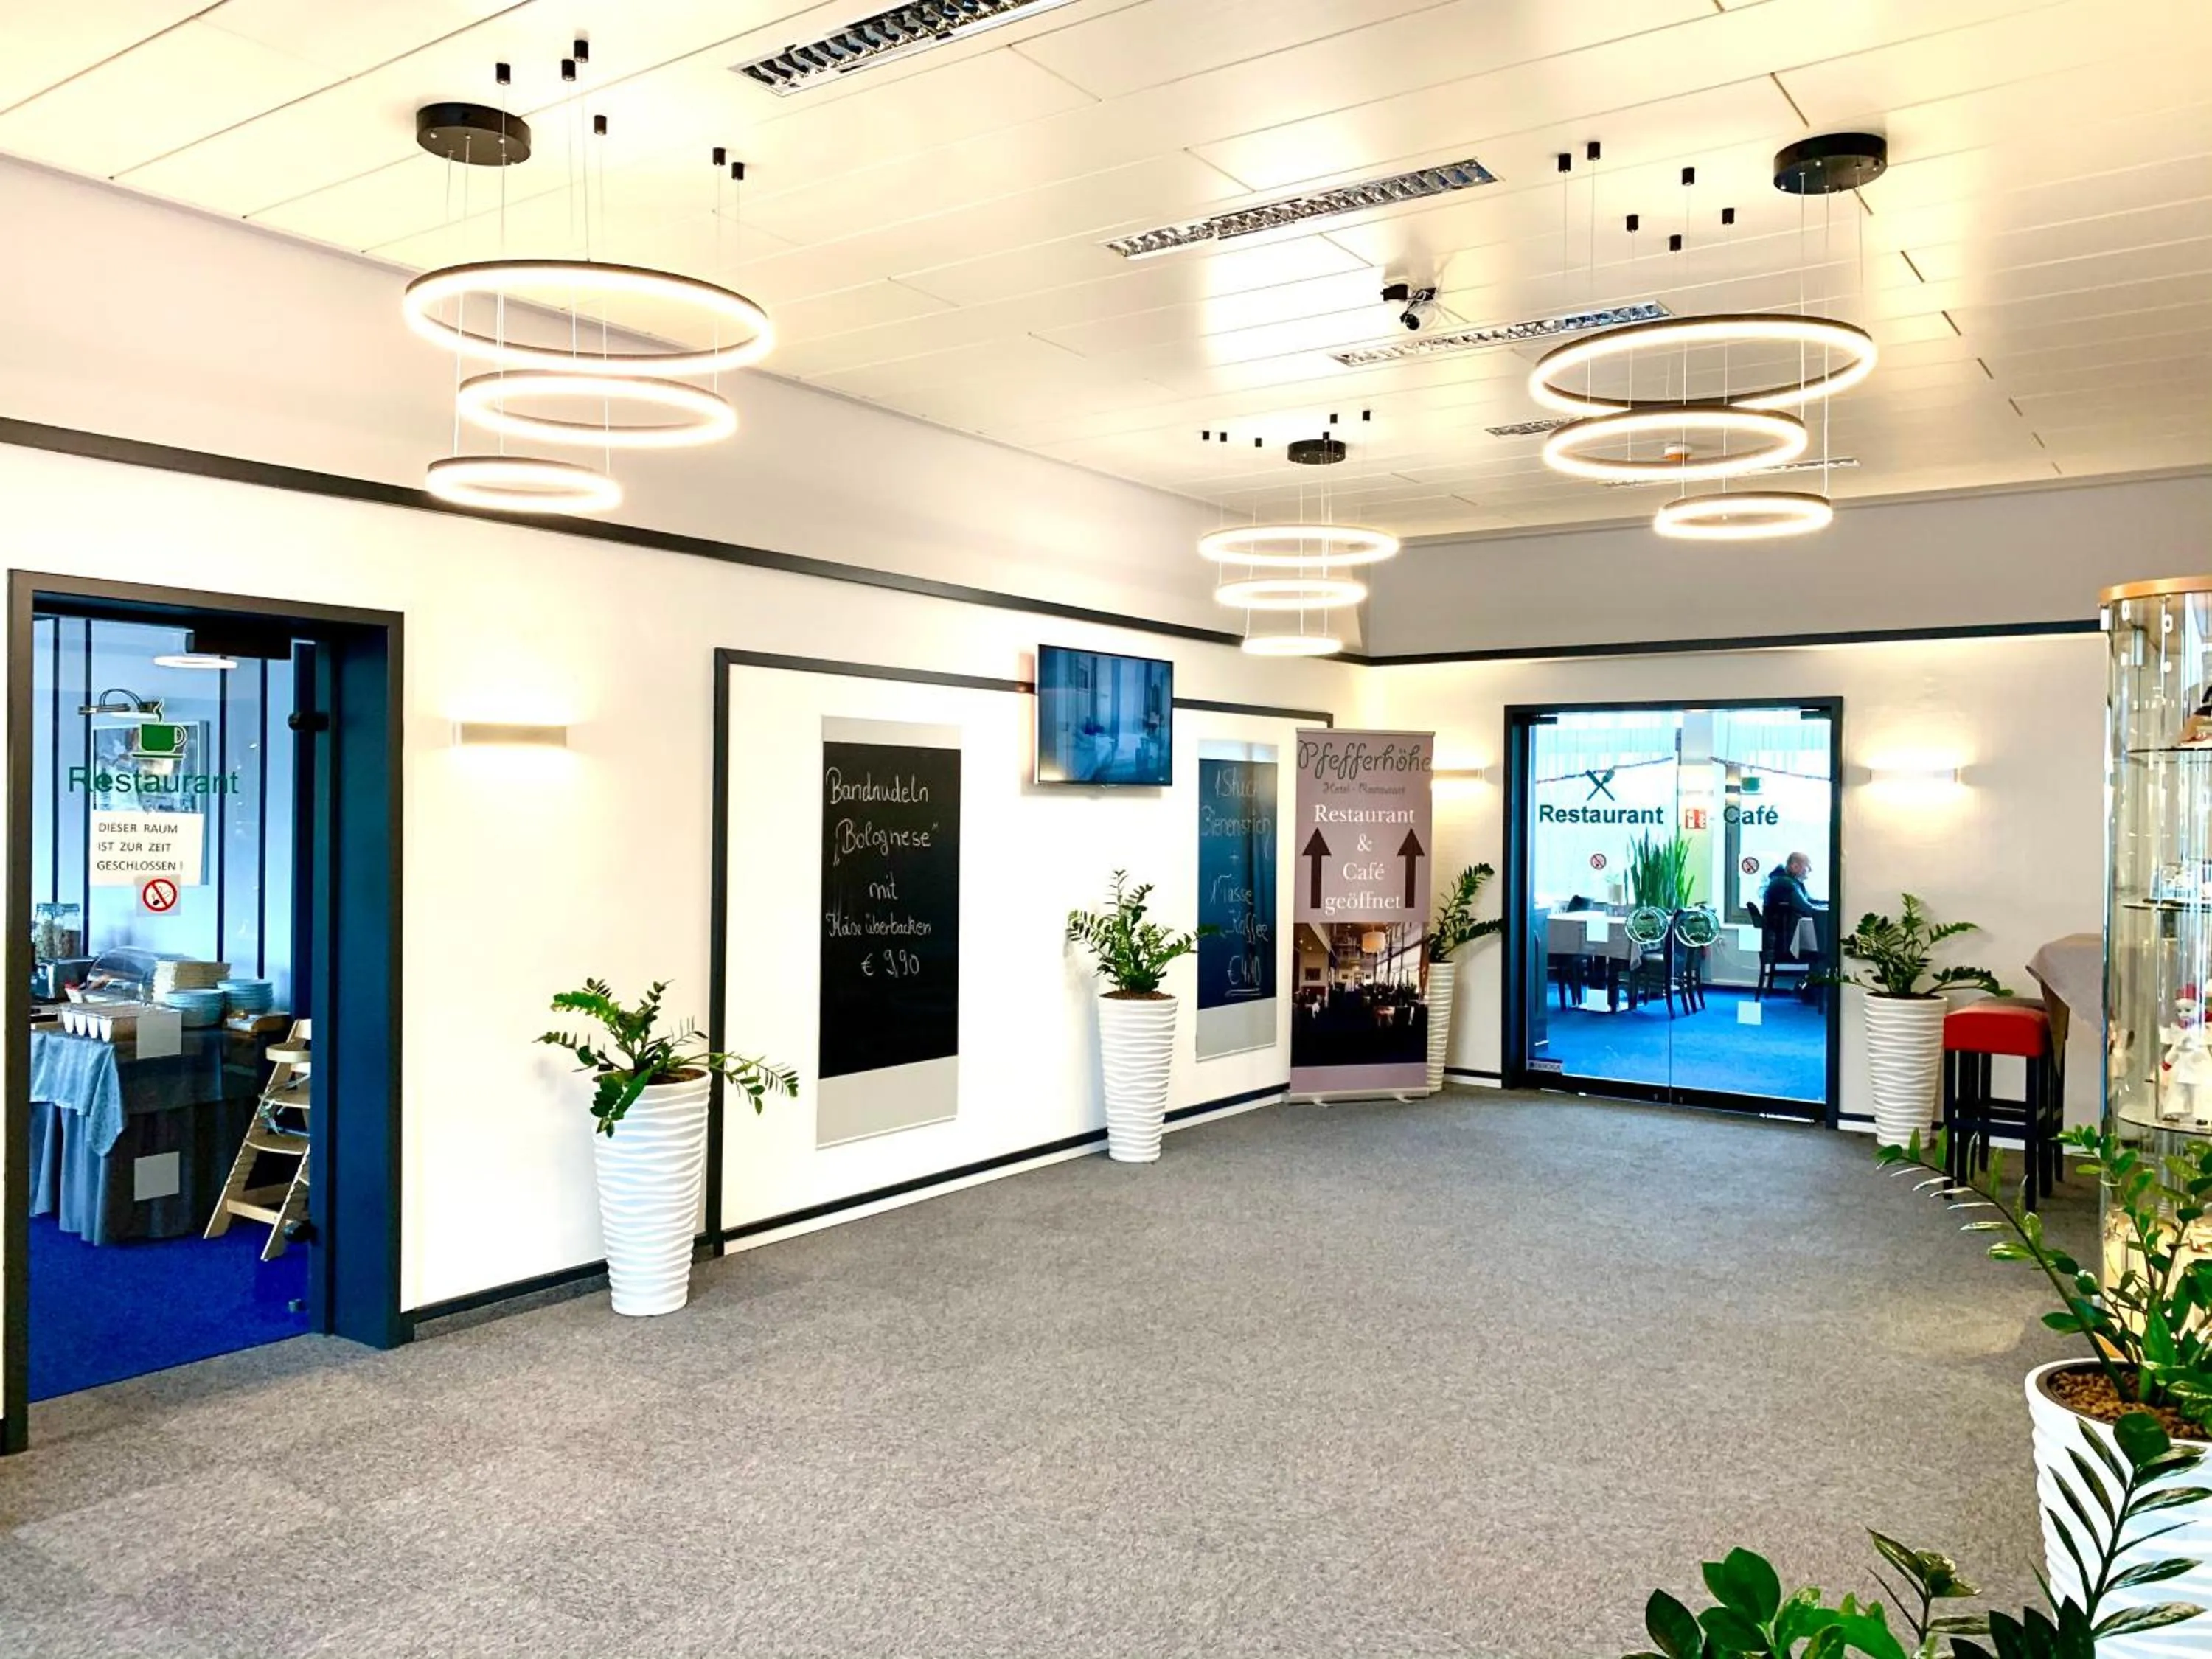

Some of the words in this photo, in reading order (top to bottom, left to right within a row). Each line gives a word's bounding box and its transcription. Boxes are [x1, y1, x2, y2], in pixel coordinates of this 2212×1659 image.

[1298, 740, 1432, 779] Pfefferhöhe
[68, 766, 239, 794] Restaurant
[826, 766, 929, 804] Bandnudeln
[1314, 804, 1416, 824] Restaurant
[1538, 804, 1664, 824] Restaurant
[1723, 805, 1779, 825] Café
[98, 823, 137, 832] DIESER
[144, 824, 178, 834] RAUM
[98, 841, 114, 852] IST
[120, 842, 142, 852] ZUR
[148, 843, 172, 852] ZEIT
[1357, 833, 1373, 852] &
[97, 860, 176, 871] GESCHLOSSEN
[1342, 861, 1385, 880] Café
[869, 872, 899, 902] mit
[1325, 891, 1401, 915] geöffnet
[865, 911, 932, 936] überbacken
[860, 952, 874, 976] €
[883, 949, 920, 978] 9,90
